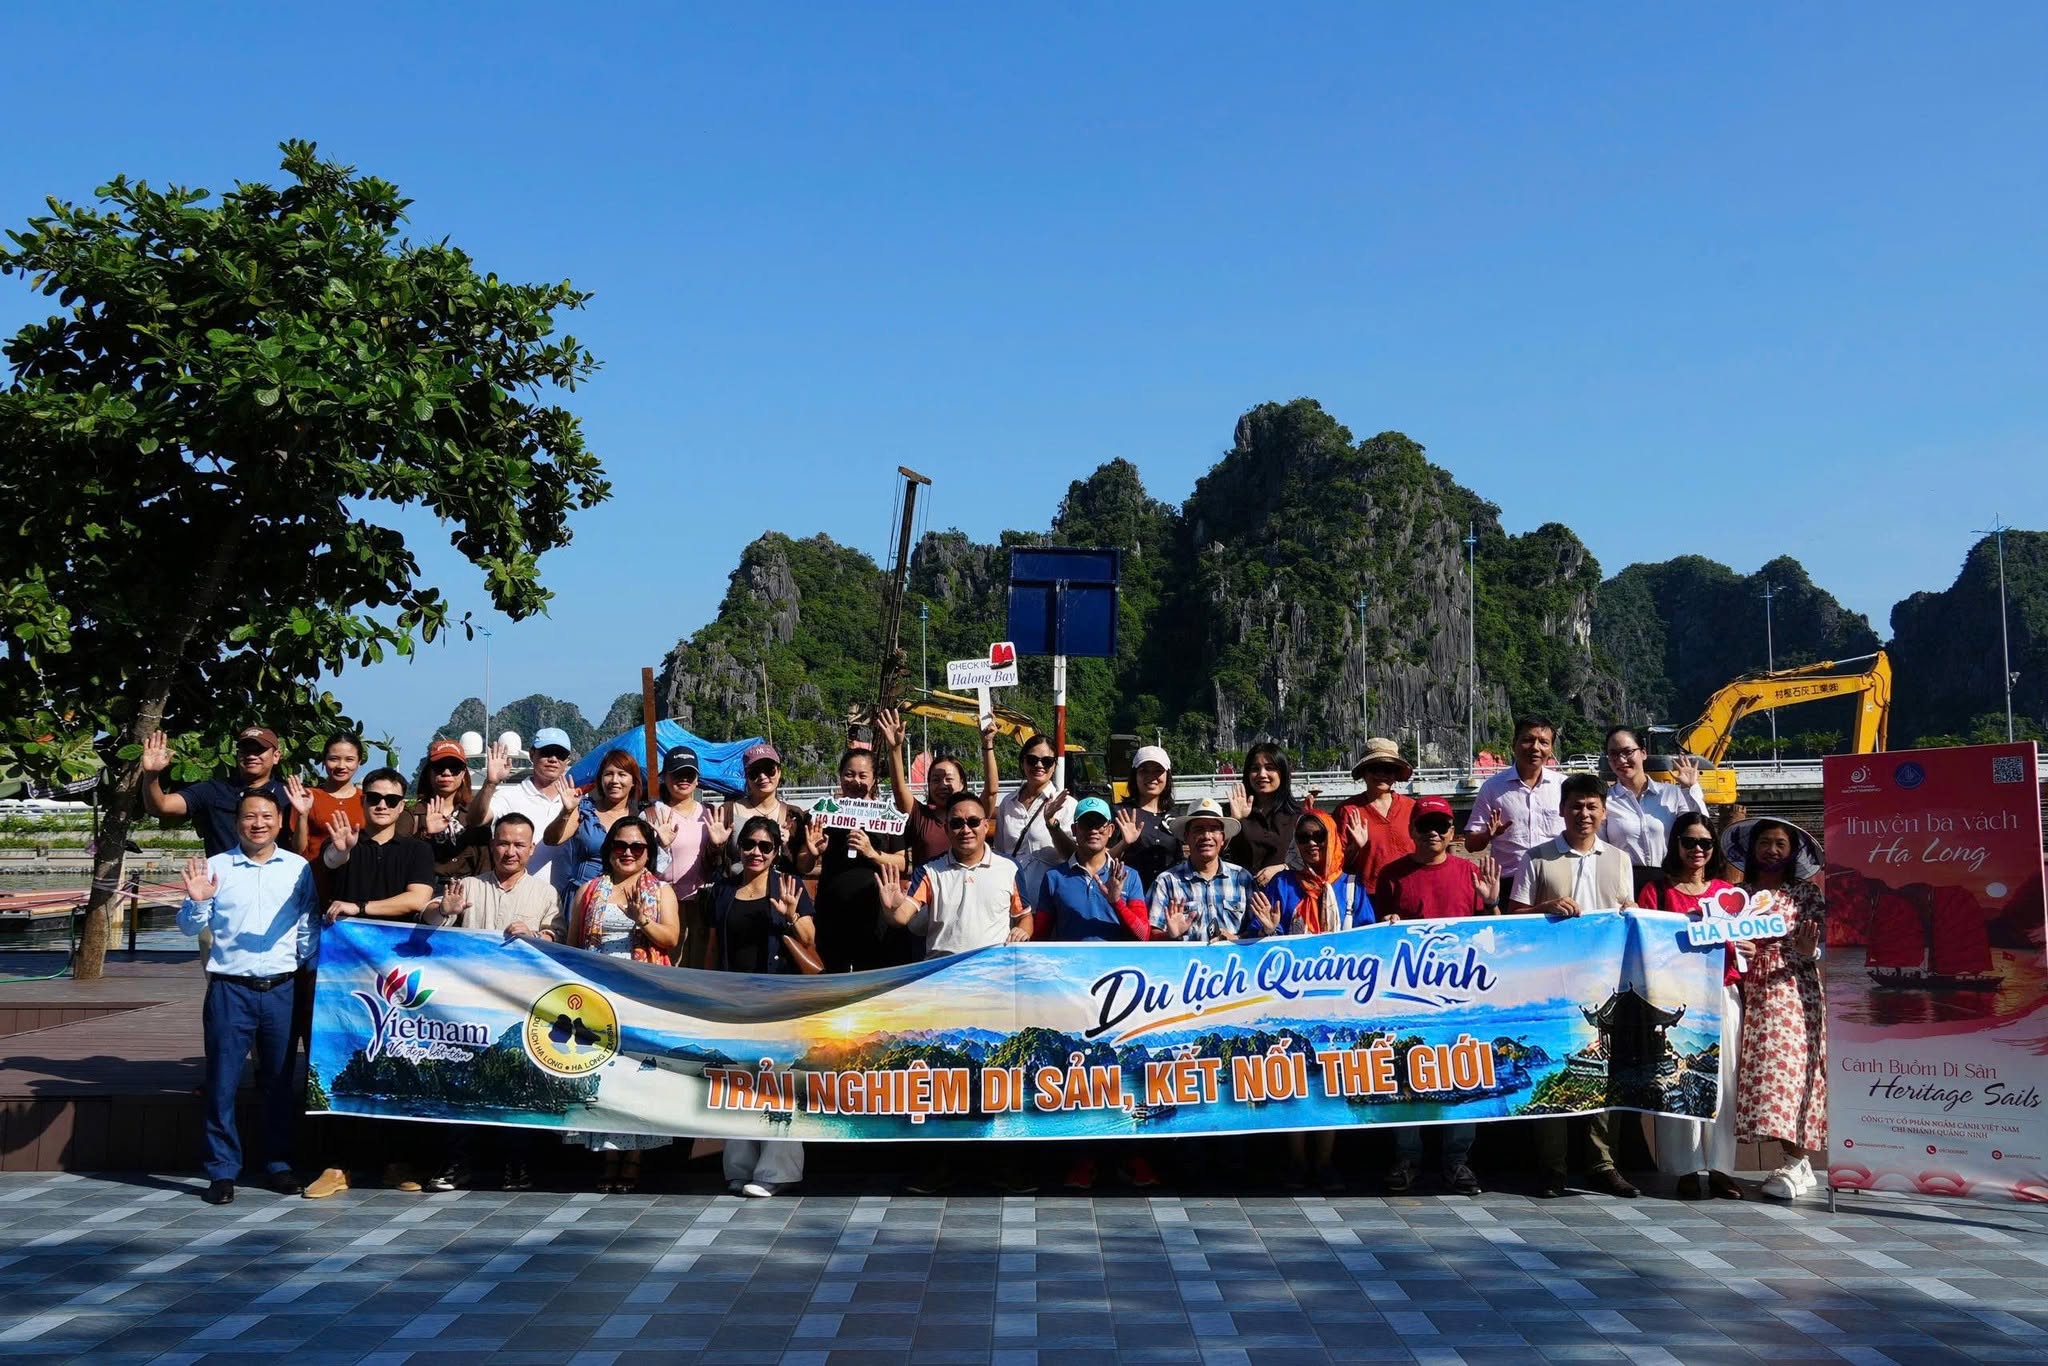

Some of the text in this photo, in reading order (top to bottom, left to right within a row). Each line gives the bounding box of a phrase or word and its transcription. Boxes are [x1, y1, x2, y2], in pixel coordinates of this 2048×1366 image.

[949, 662, 980, 671] CHECK
[951, 670, 1016, 686] Halong Bay
[832, 815, 857, 828] LONG
[868, 817, 887, 831] YÊN
[1842, 810, 2018, 839] Thuyền ba vách
[1868, 837, 1991, 872] Hạ Long
[1702, 902, 1712, 918] I
[1691, 917, 1784, 942] HA LONG
[1084, 938, 1498, 1039] Du lịch Quảng Ninh
[354, 991, 491, 1061] Vietnam
[543, 1055, 564, 1070] LONG
[571, 1063, 583, 1071] HA
[584, 1053, 606, 1069] LONG
[1943, 1062, 1959, 1077] Di
[704, 1033, 1496, 1123] TRẢI NGHIỆM DI SẢN, KẾT NỐI THẾ GIỚI
[1869, 1075, 2042, 1112] Heritage Sails
[1967, 1131, 1988, 1139] NINH
[2001, 1125, 2020, 1133] NAM
